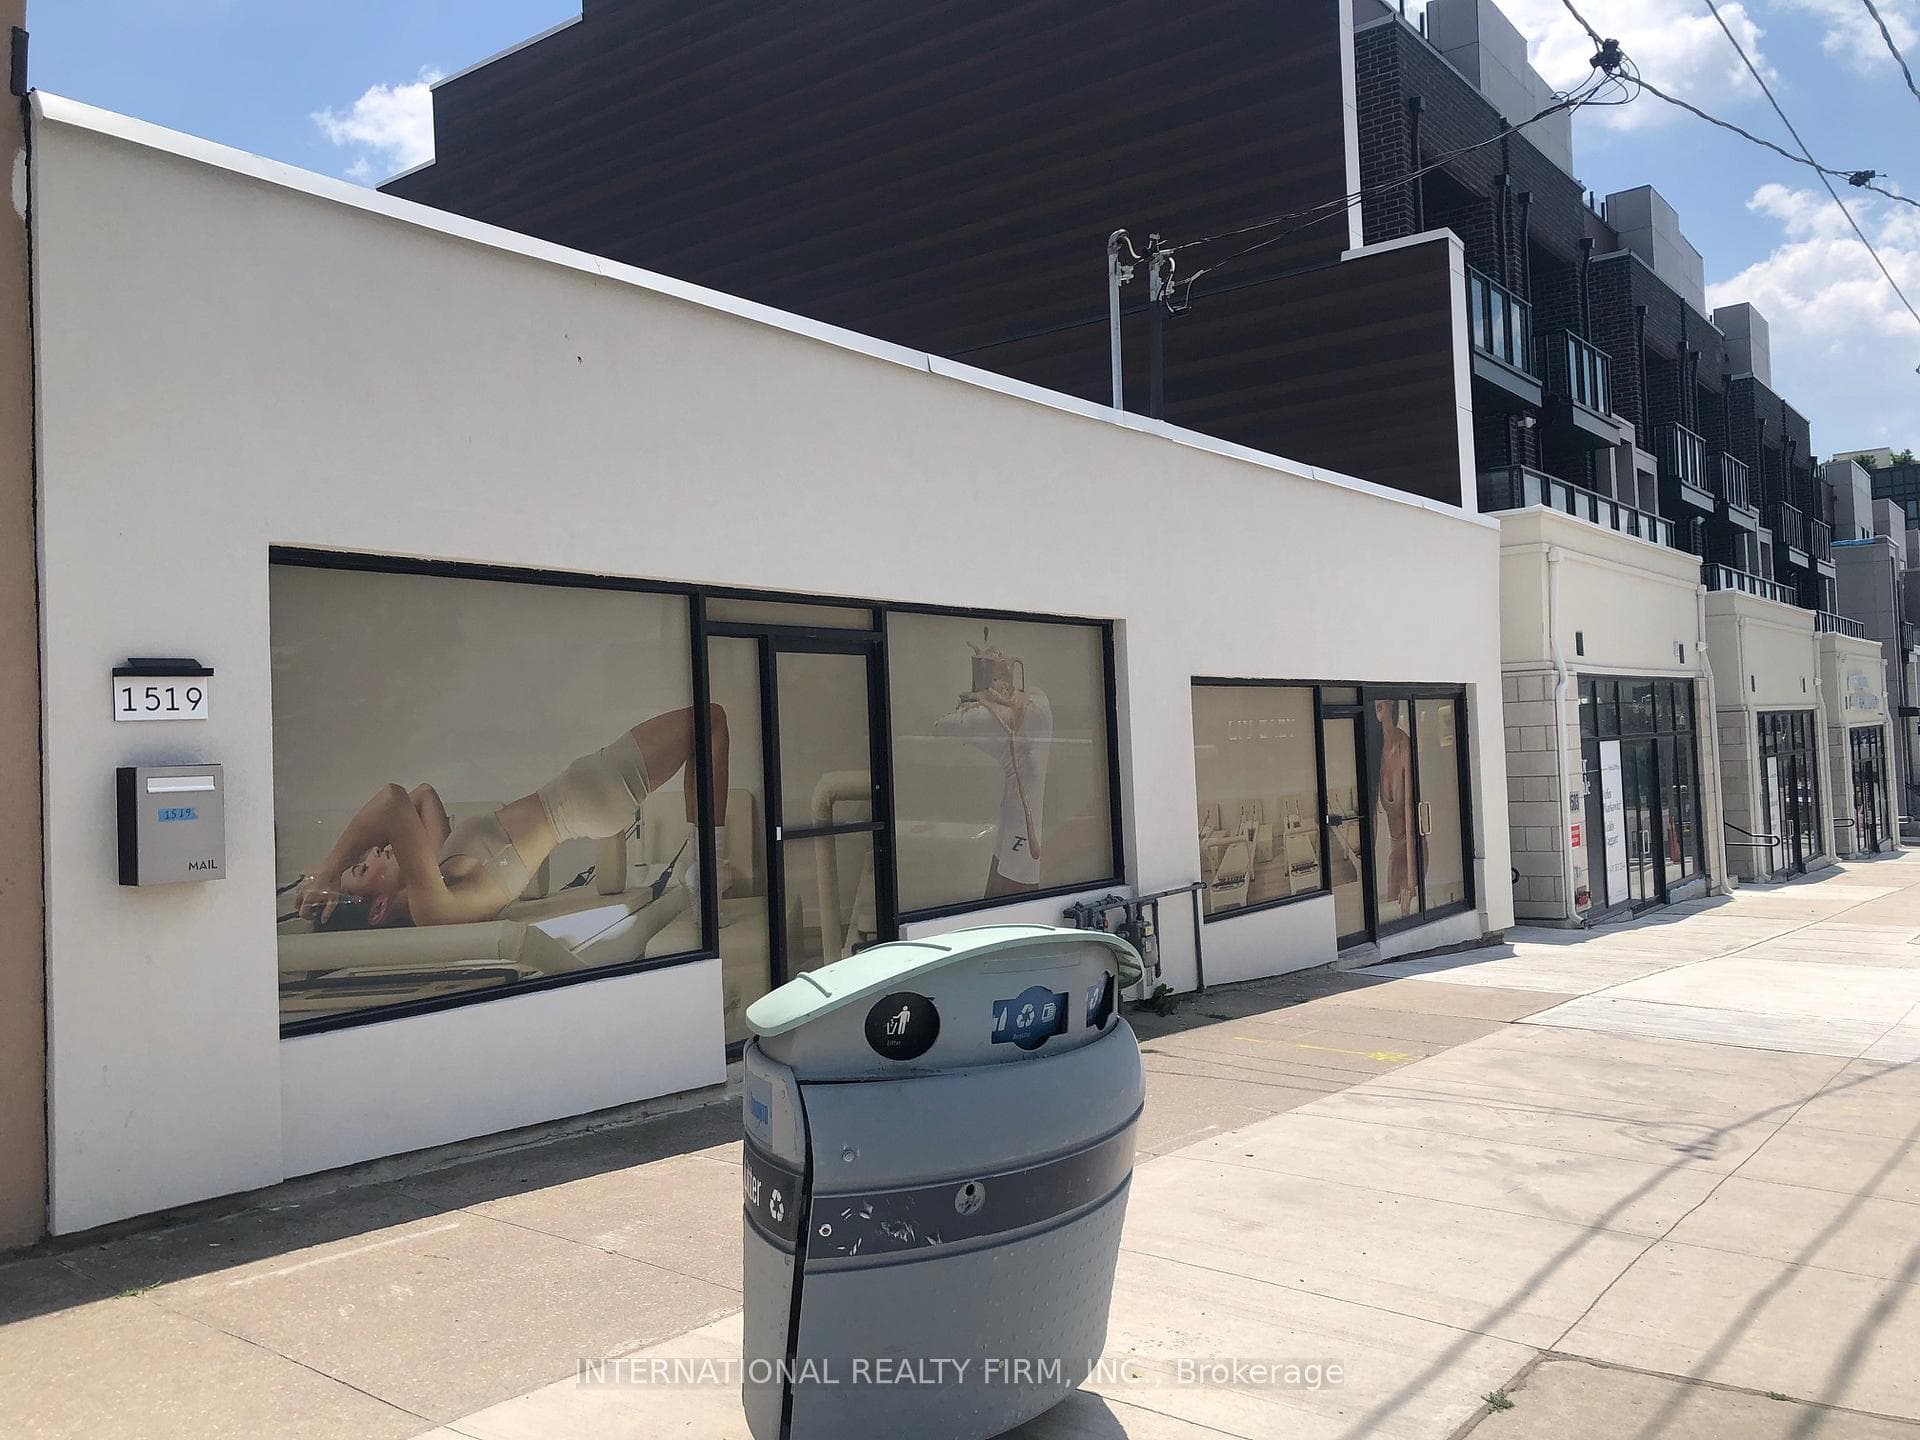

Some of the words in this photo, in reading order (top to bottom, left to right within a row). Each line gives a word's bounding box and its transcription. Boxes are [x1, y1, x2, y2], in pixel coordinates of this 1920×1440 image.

[122, 686, 203, 712] 1519
[165, 808, 192, 820] 1519
[188, 859, 218, 871] MAIL
